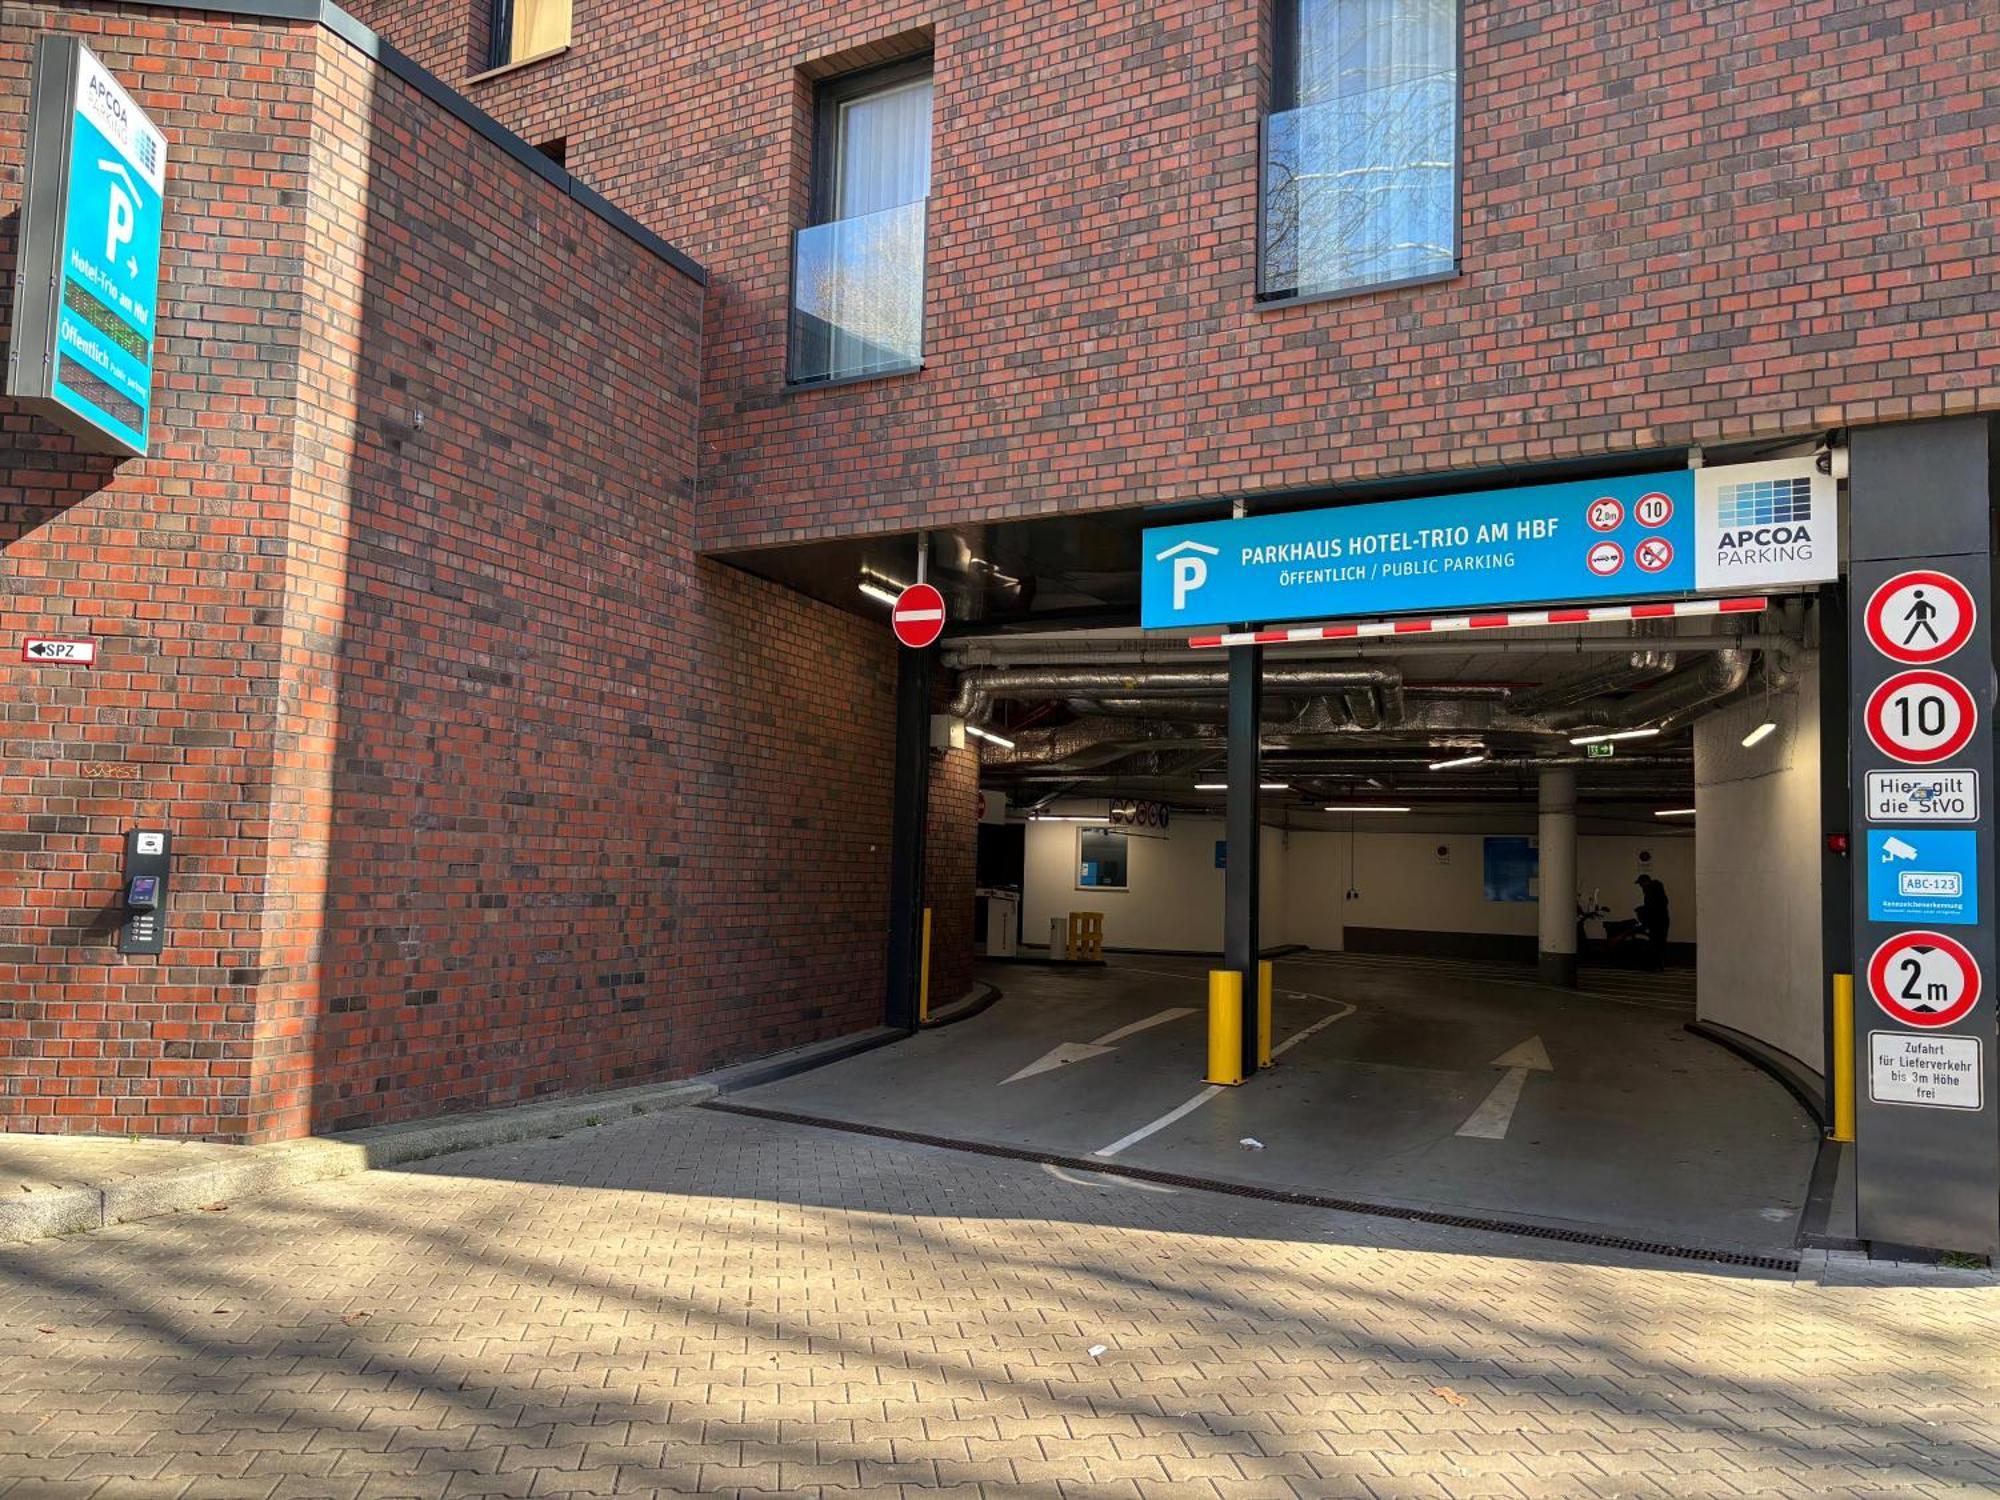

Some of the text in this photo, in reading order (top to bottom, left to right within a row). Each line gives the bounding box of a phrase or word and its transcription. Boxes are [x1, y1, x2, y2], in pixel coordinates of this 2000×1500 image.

[89, 74, 128, 127] APCOA
[105, 181, 136, 264] P
[72, 248, 118, 300] Hotel-Trio
[119, 293, 133, 312] am
[61, 317, 109, 370] Öffentlich
[1645, 501, 1662, 518] 10
[1241, 518, 1559, 566] PARKHAUS HOTEL-TRIO AM HBF
[1718, 525, 1812, 549] APCOA
[1718, 544, 1813, 566] PARKING
[1279, 552, 1515, 586] ÖFFENTLICH / PUBLIC PARKING
[1173, 556, 1208, 610] P
[46, 643, 75, 658] SPZ
[1895, 695, 1946, 737] 10
[1880, 778, 1963, 797] Hier gilt
[1880, 798, 1965, 813] die StVO
[1907, 879, 1955, 890] ABC-123
[1905, 1042, 1944, 1055] Zufahrt
[1879, 1055, 1972, 1072] für Lieferverkehr
[1891, 1070, 1907, 1082] bis
[1933, 1073, 1960, 1086] Höhe
[1916, 1087, 1936, 1099] frei
